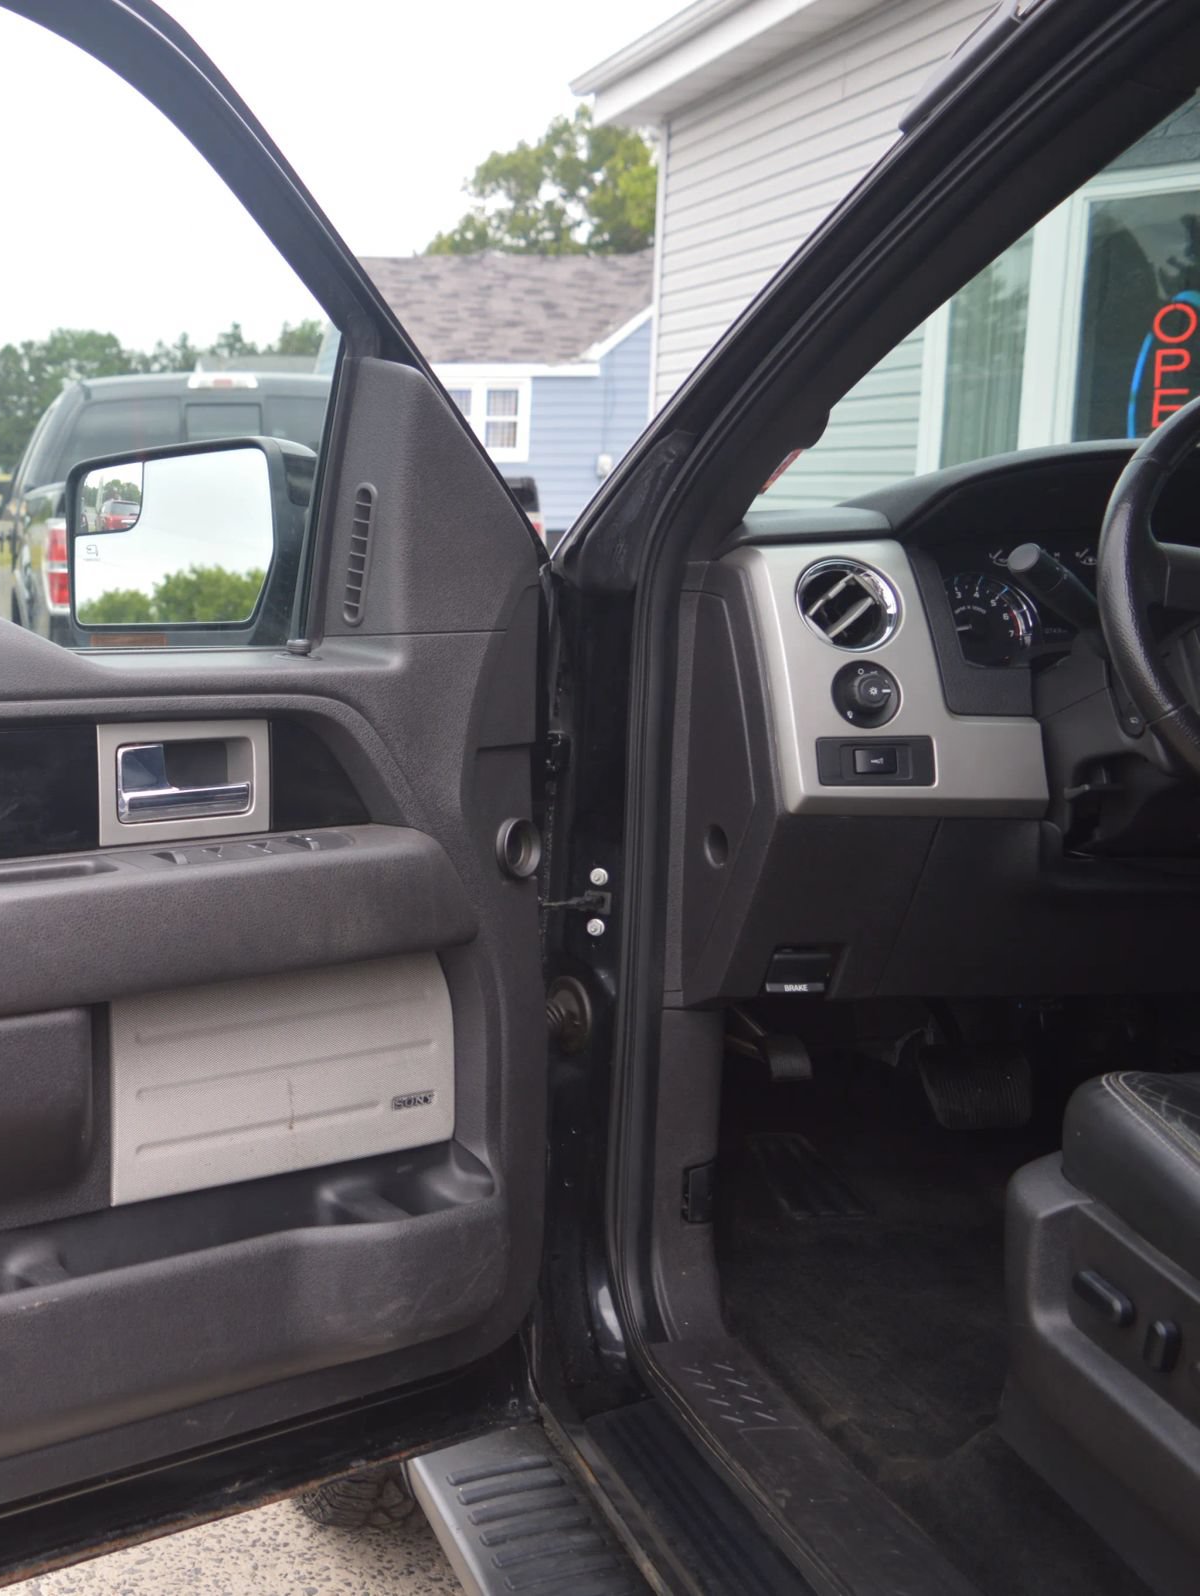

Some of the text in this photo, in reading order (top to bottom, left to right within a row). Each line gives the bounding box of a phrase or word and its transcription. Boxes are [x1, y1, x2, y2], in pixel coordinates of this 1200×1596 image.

[1151, 303, 1197, 428] OPE
[784, 984, 808, 992] BRAKE
[393, 1093, 433, 1110] SONY
